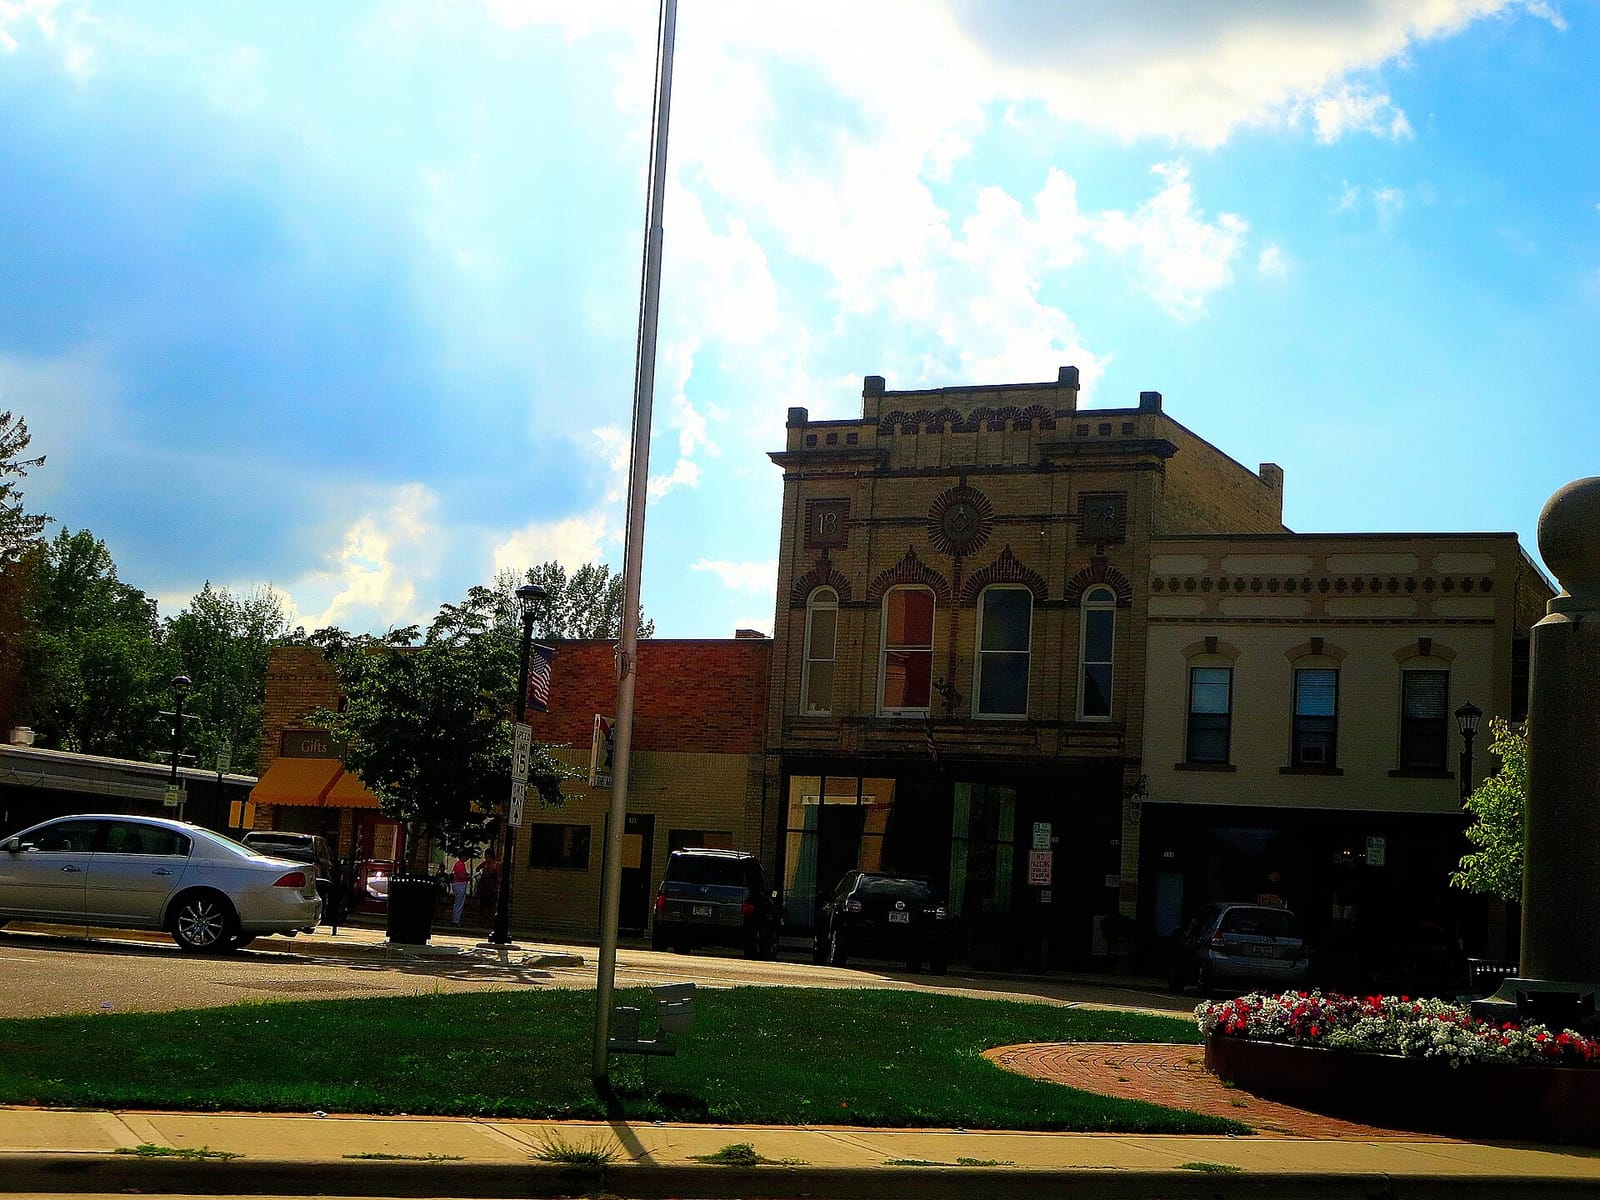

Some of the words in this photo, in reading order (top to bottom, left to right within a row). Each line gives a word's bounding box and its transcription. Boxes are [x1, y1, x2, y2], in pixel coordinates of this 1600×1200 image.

[818, 511, 837, 535] 18
[516, 729, 530, 740] SPEED
[301, 738, 329, 753] Gifts
[516, 741, 528, 751] LIMIT
[516, 753, 526, 774] 15
[512, 783, 524, 796] ONE
[511, 797, 523, 809] WAY
